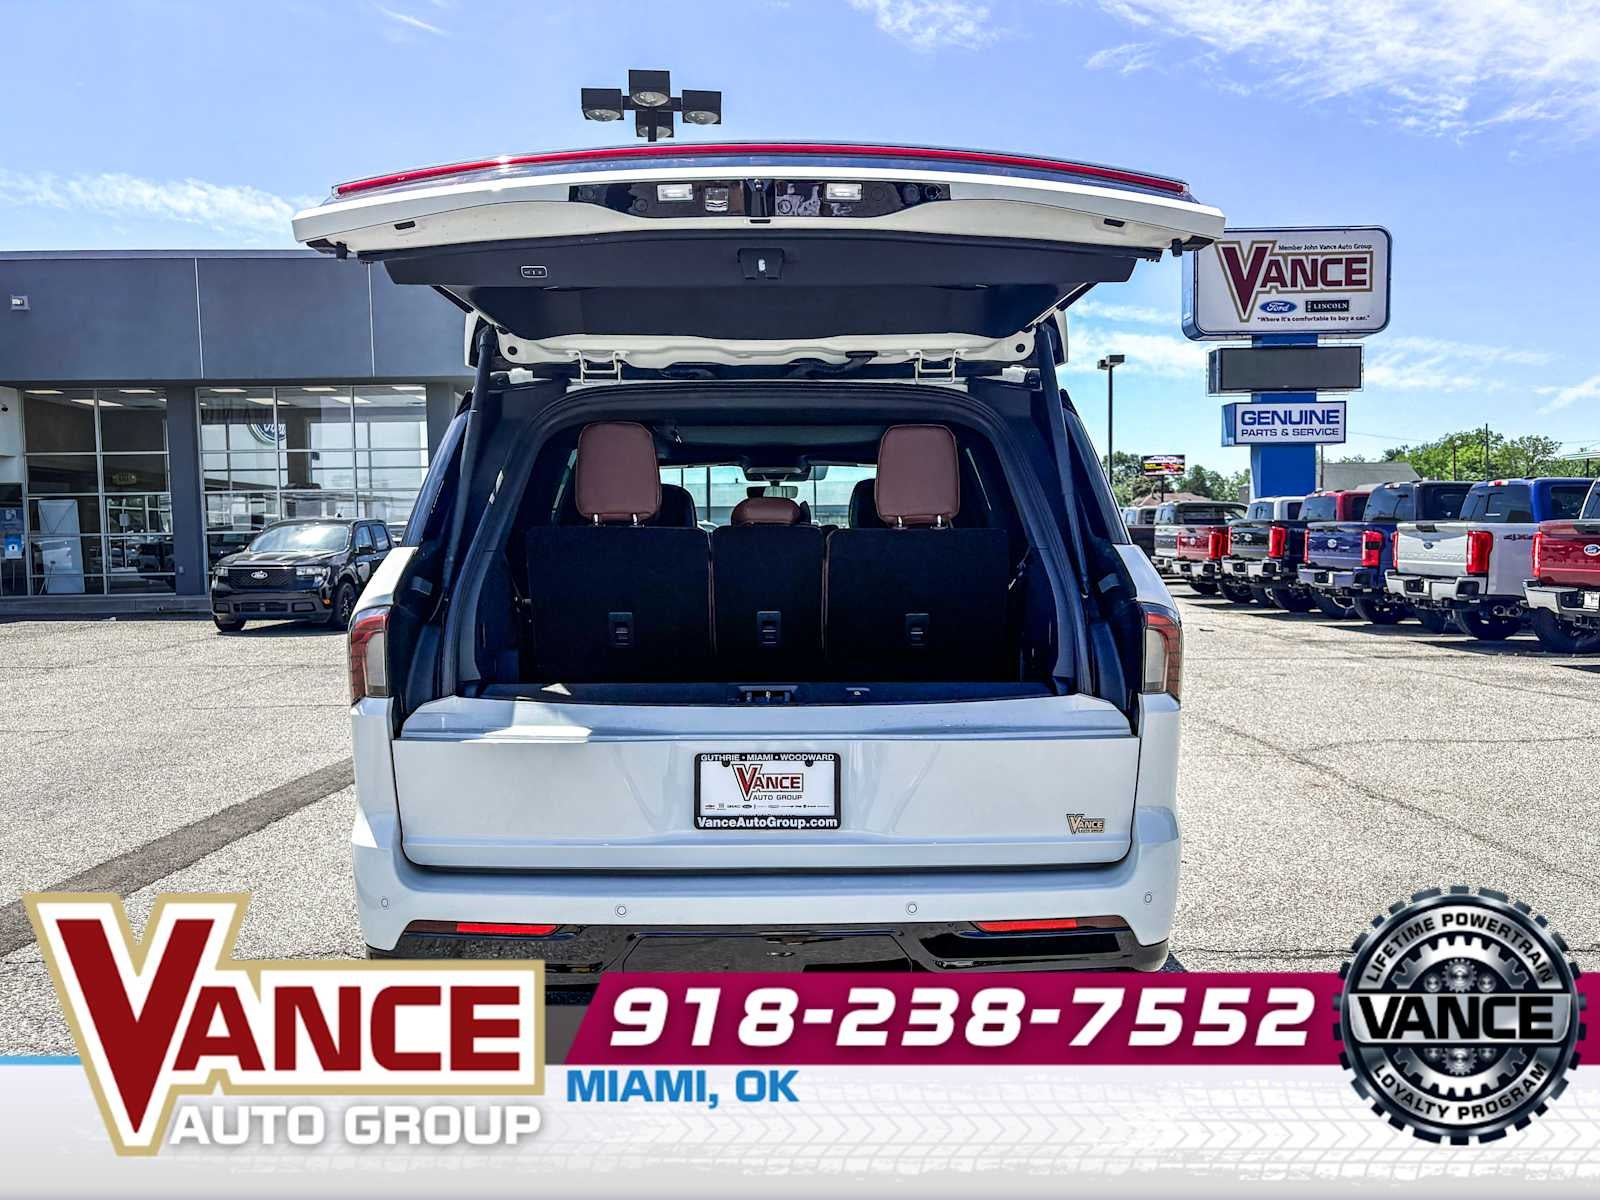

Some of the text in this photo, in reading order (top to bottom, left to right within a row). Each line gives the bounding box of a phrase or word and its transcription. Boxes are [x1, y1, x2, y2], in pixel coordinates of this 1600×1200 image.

[1266, 302, 1290, 313] Ford
[1241, 409, 1340, 426] GENUINE
[1241, 428, 1340, 437] PARTS & SERVICE
[736, 767, 801, 796] VANCE
[697, 816, 838, 829] VanceAutoGroup.com
